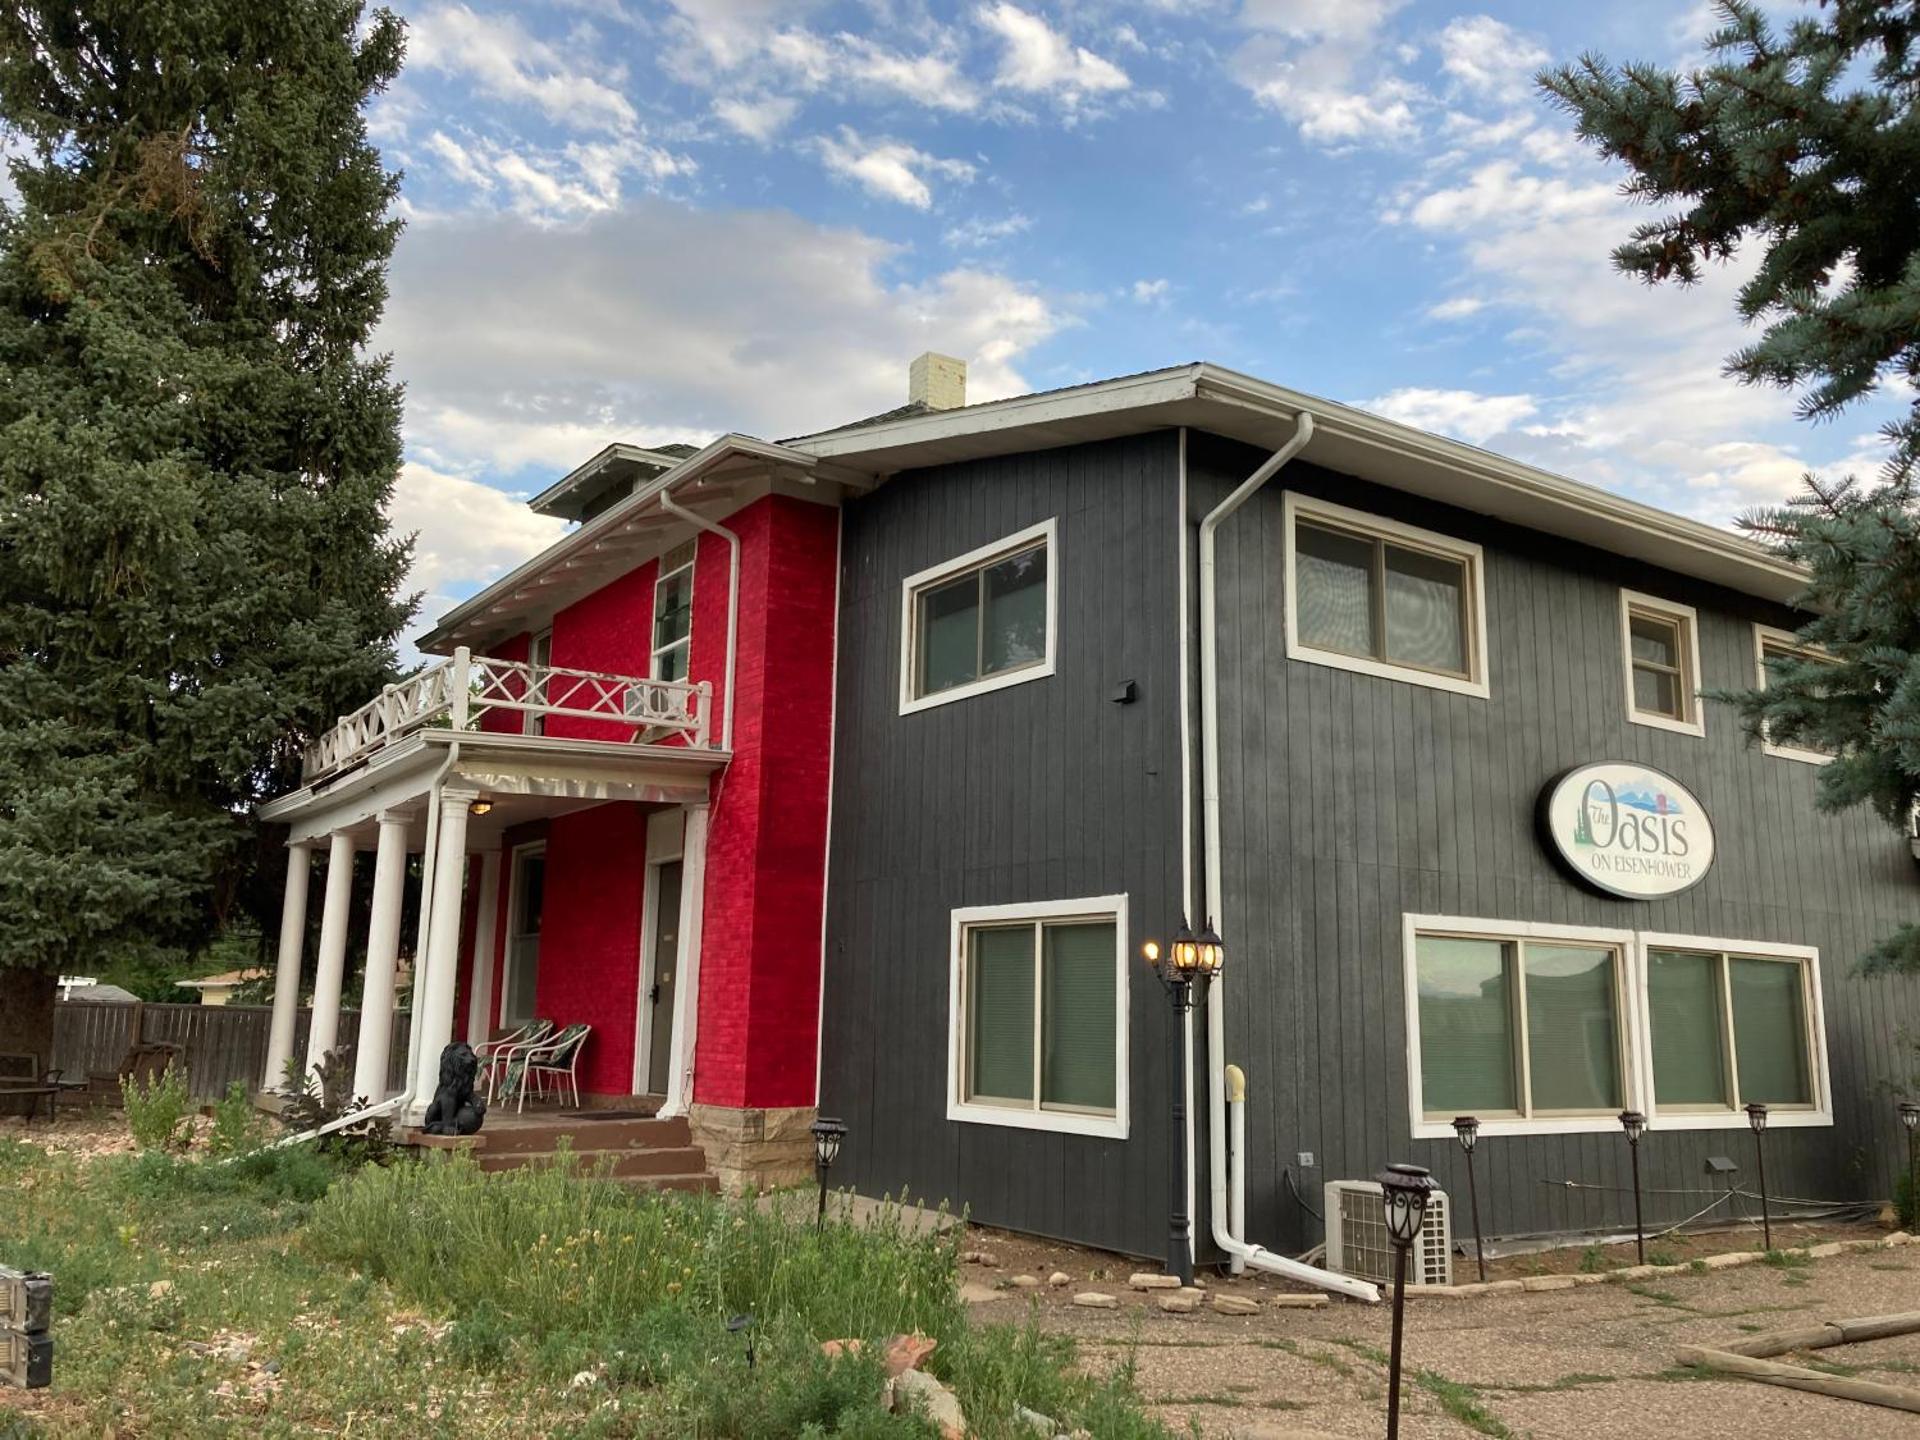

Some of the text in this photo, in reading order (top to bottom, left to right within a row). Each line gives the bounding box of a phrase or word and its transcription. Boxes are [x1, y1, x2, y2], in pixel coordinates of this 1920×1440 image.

[1590, 805, 1611, 825] The
[1592, 853, 1691, 879] ON EISENHOWER
